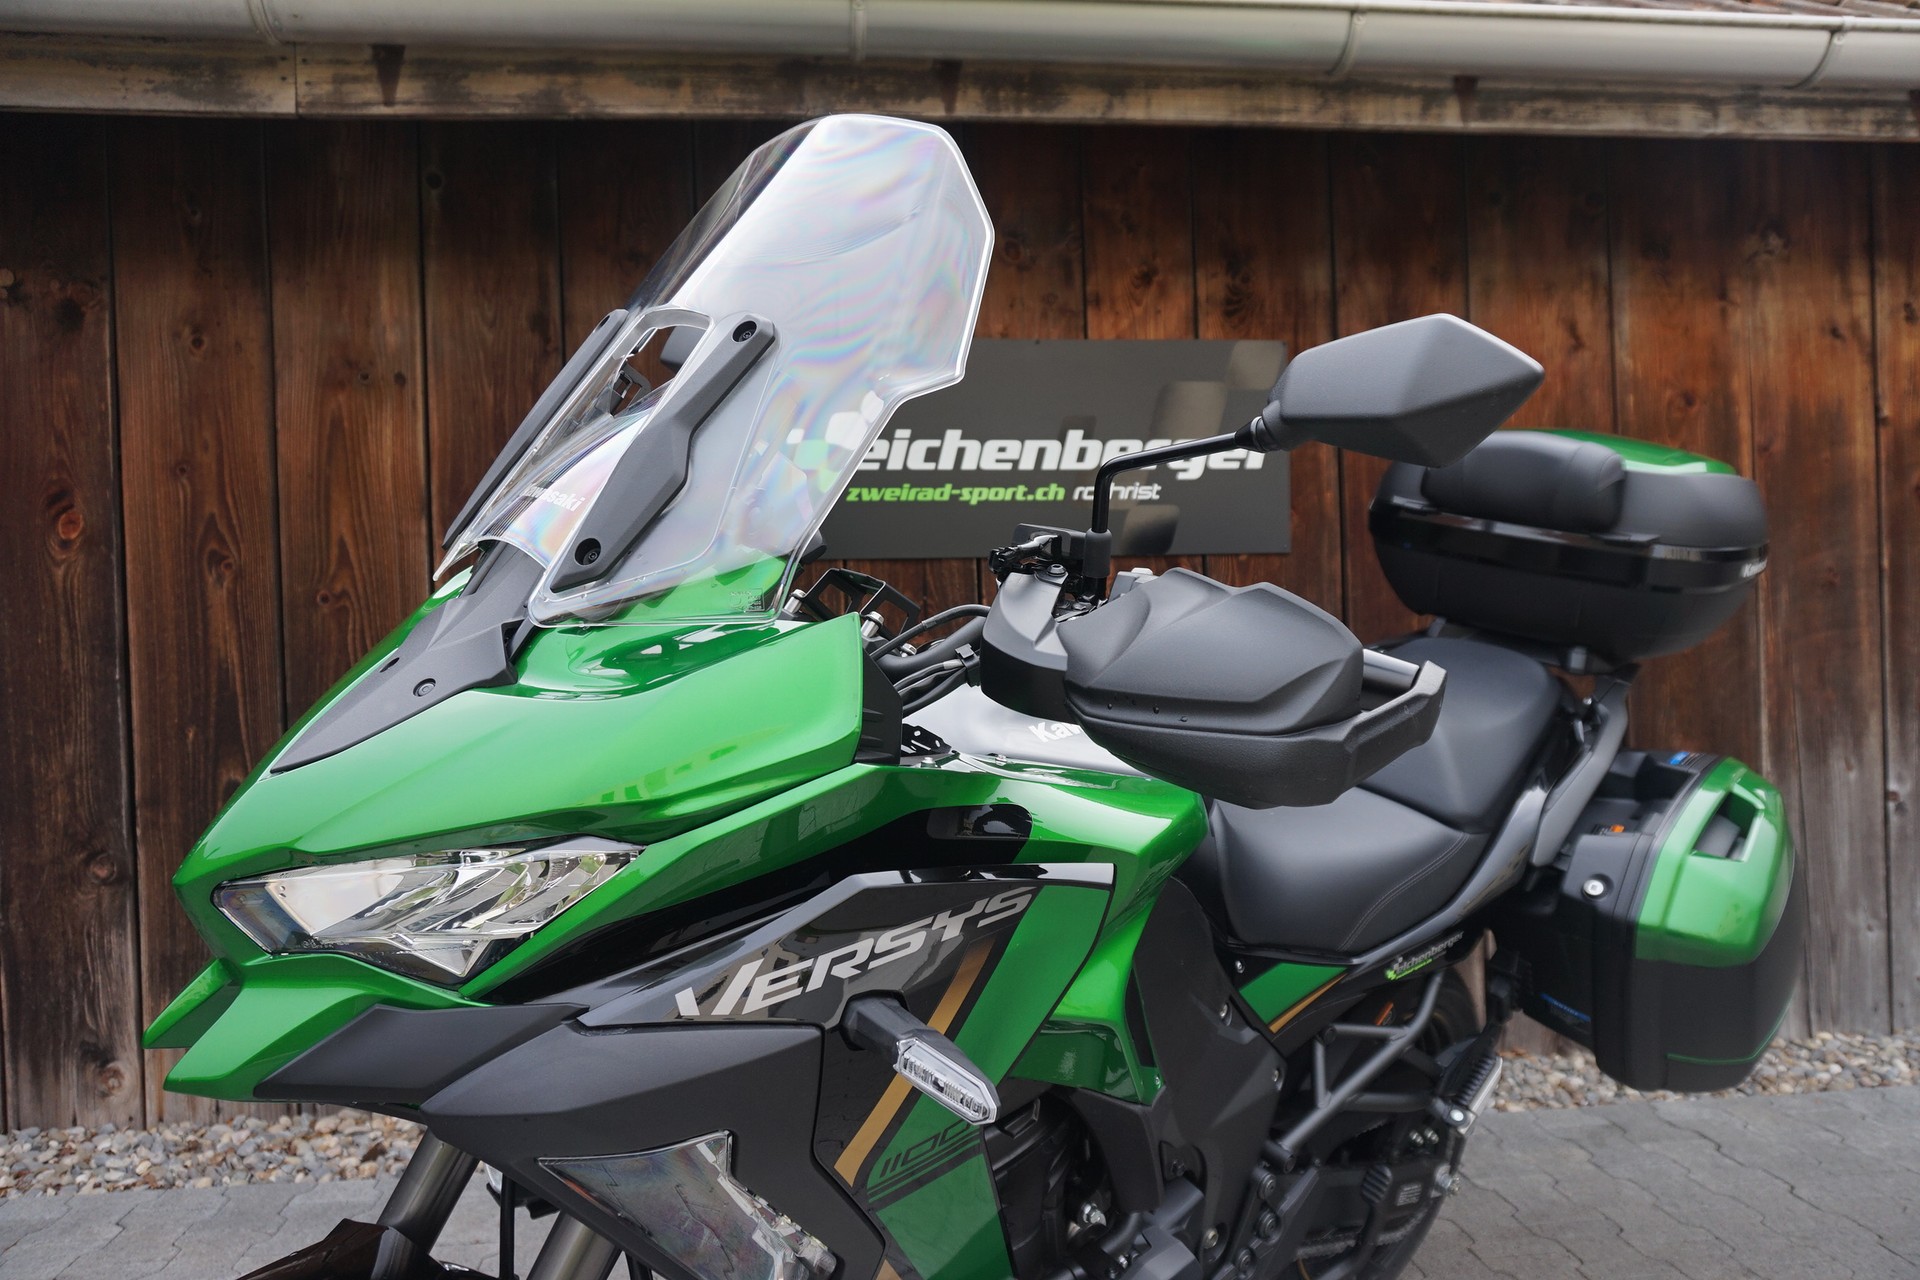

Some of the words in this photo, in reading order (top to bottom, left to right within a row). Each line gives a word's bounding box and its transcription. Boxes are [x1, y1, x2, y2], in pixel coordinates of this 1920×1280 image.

[846, 483, 1066, 506] zweirad-sport.ch
[1072, 481, 1162, 501] rohrist
[675, 886, 1038, 1016] VERSYS
